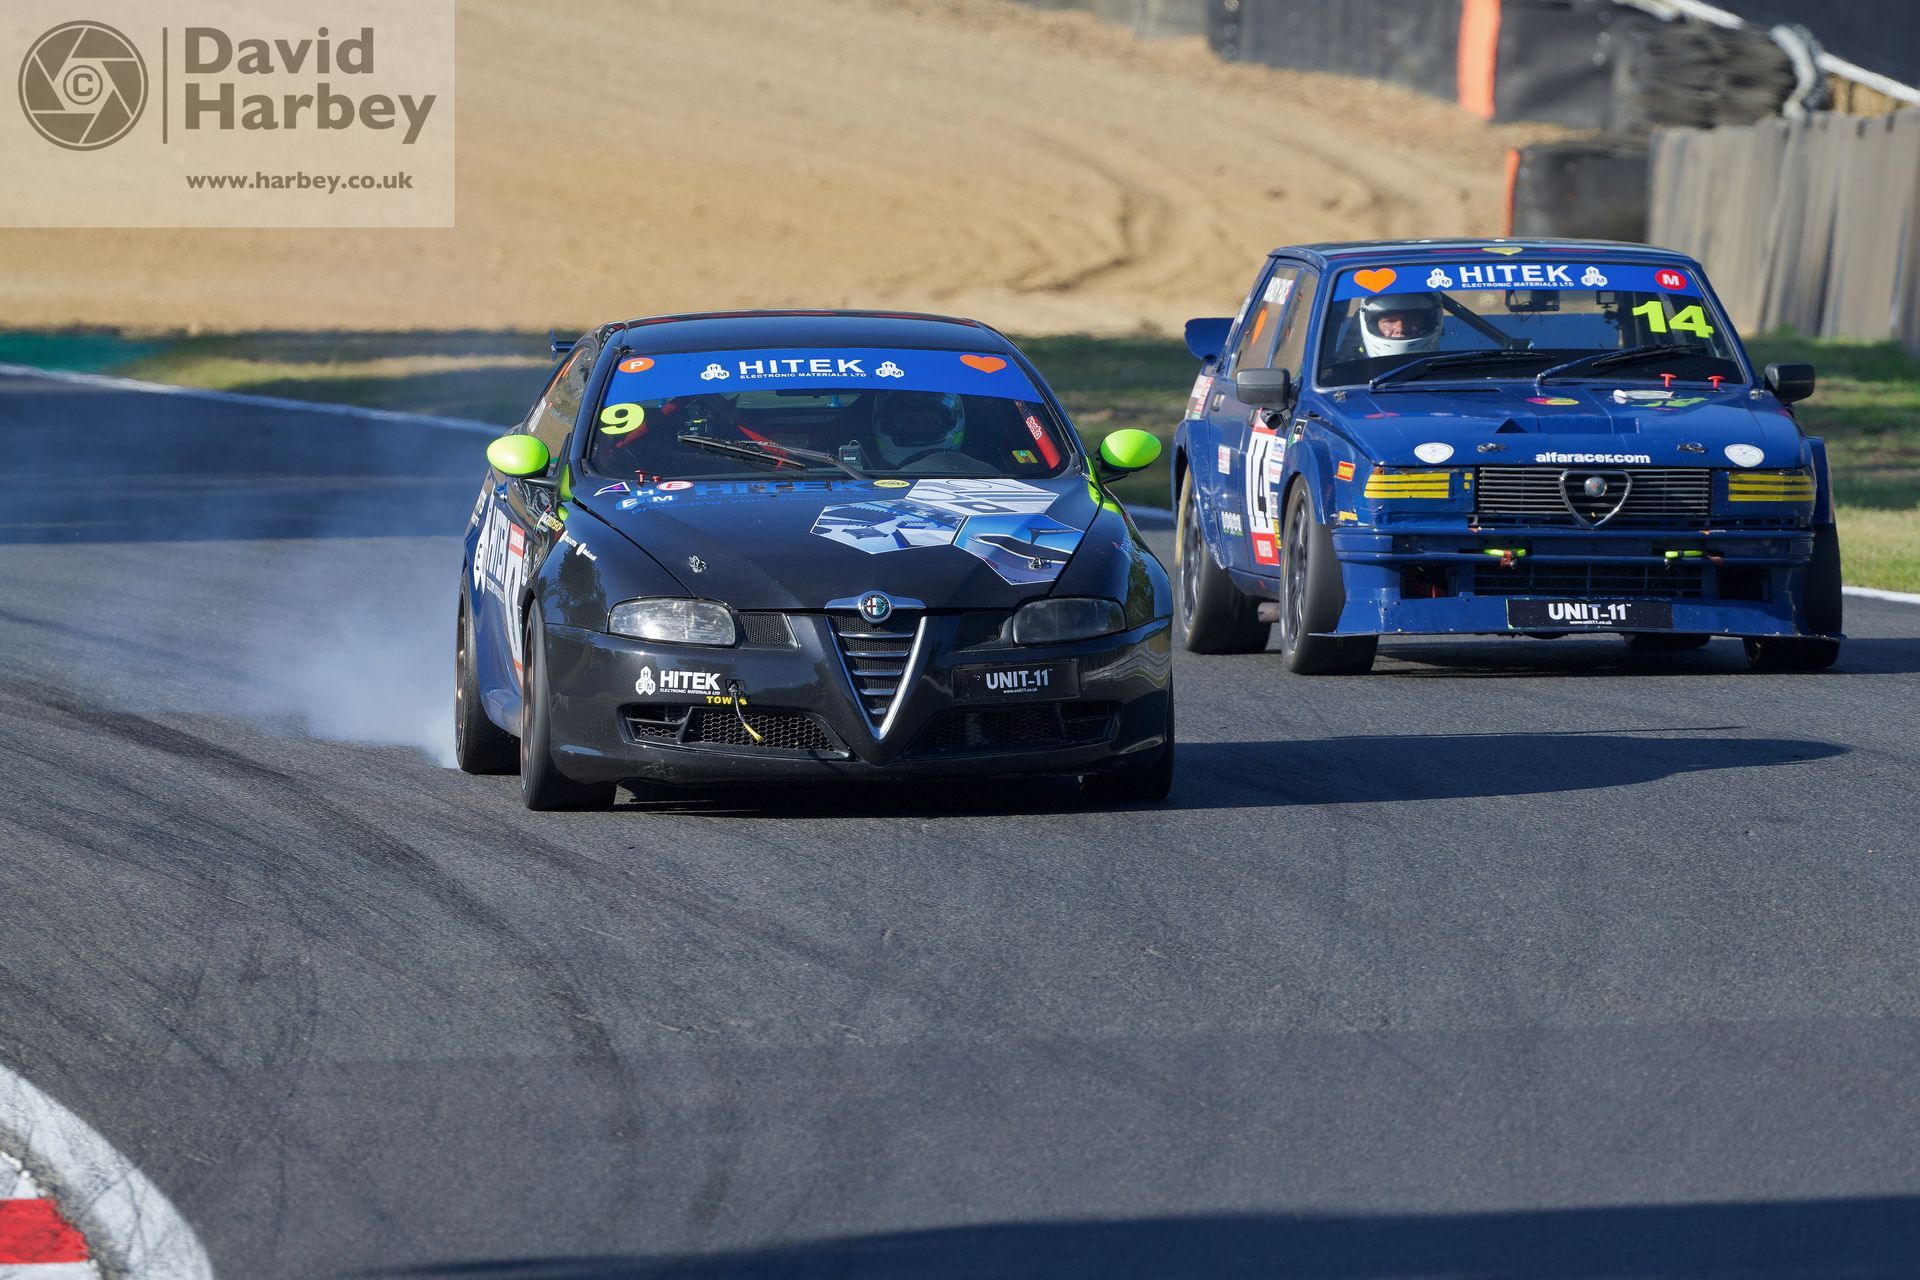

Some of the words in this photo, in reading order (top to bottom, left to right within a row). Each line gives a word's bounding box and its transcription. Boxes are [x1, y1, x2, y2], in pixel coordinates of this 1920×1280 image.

[1458, 265, 1573, 283] HITEK
[1662, 274, 1680, 286] M
[1632, 300, 1715, 338] 14
[630, 360, 644, 370] P
[738, 359, 865, 375] HITEK
[600, 403, 645, 435] 9
[1535, 451, 1651, 465] alfaracer.com
[694, 481, 872, 496] HITEK
[660, 670, 721, 691] HITEK
[706, 695, 733, 705] TOW
